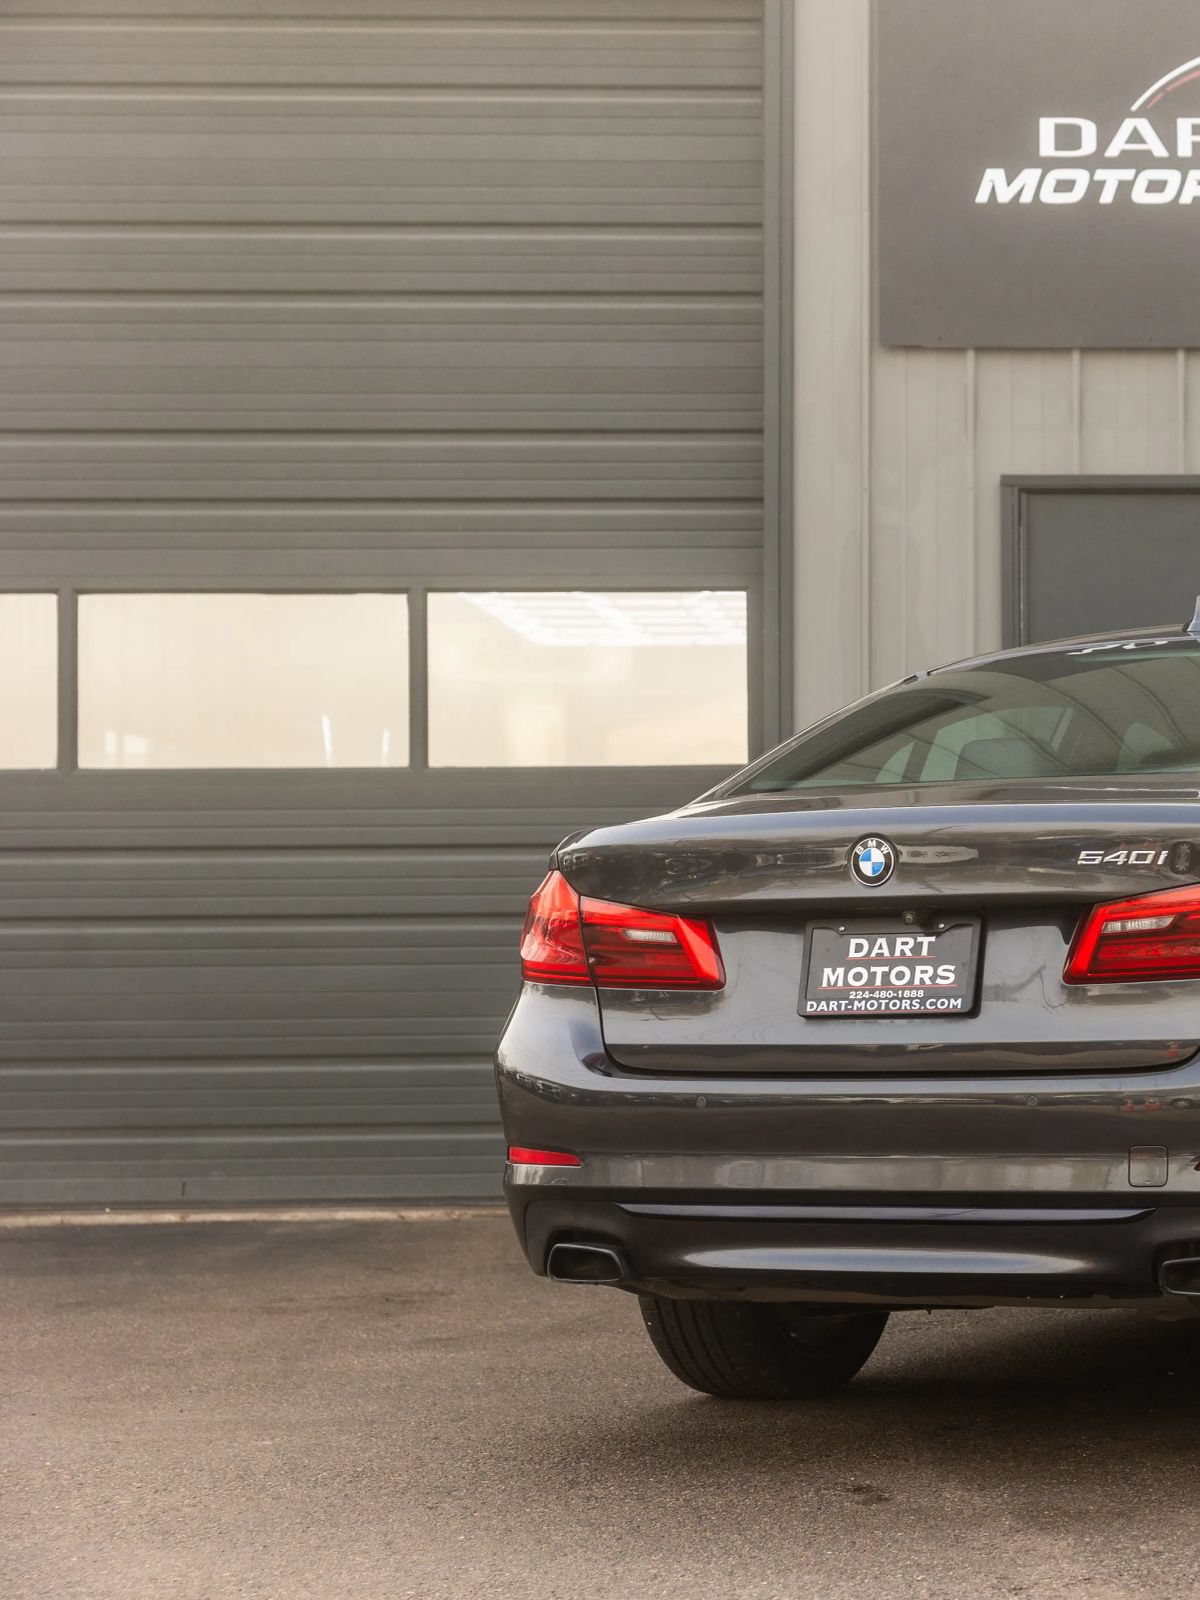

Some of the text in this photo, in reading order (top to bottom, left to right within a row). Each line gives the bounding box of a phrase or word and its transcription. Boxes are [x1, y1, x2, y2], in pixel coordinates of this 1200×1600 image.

[855, 840, 890, 854] BMW
[1077, 851, 1169, 865] 540i
[848, 936, 937, 958] DART
[822, 965, 957, 988] MOTORS
[849, 990, 924, 999] 224-480-1888
[806, 998, 962, 1012] DART-MOTORS.COM
